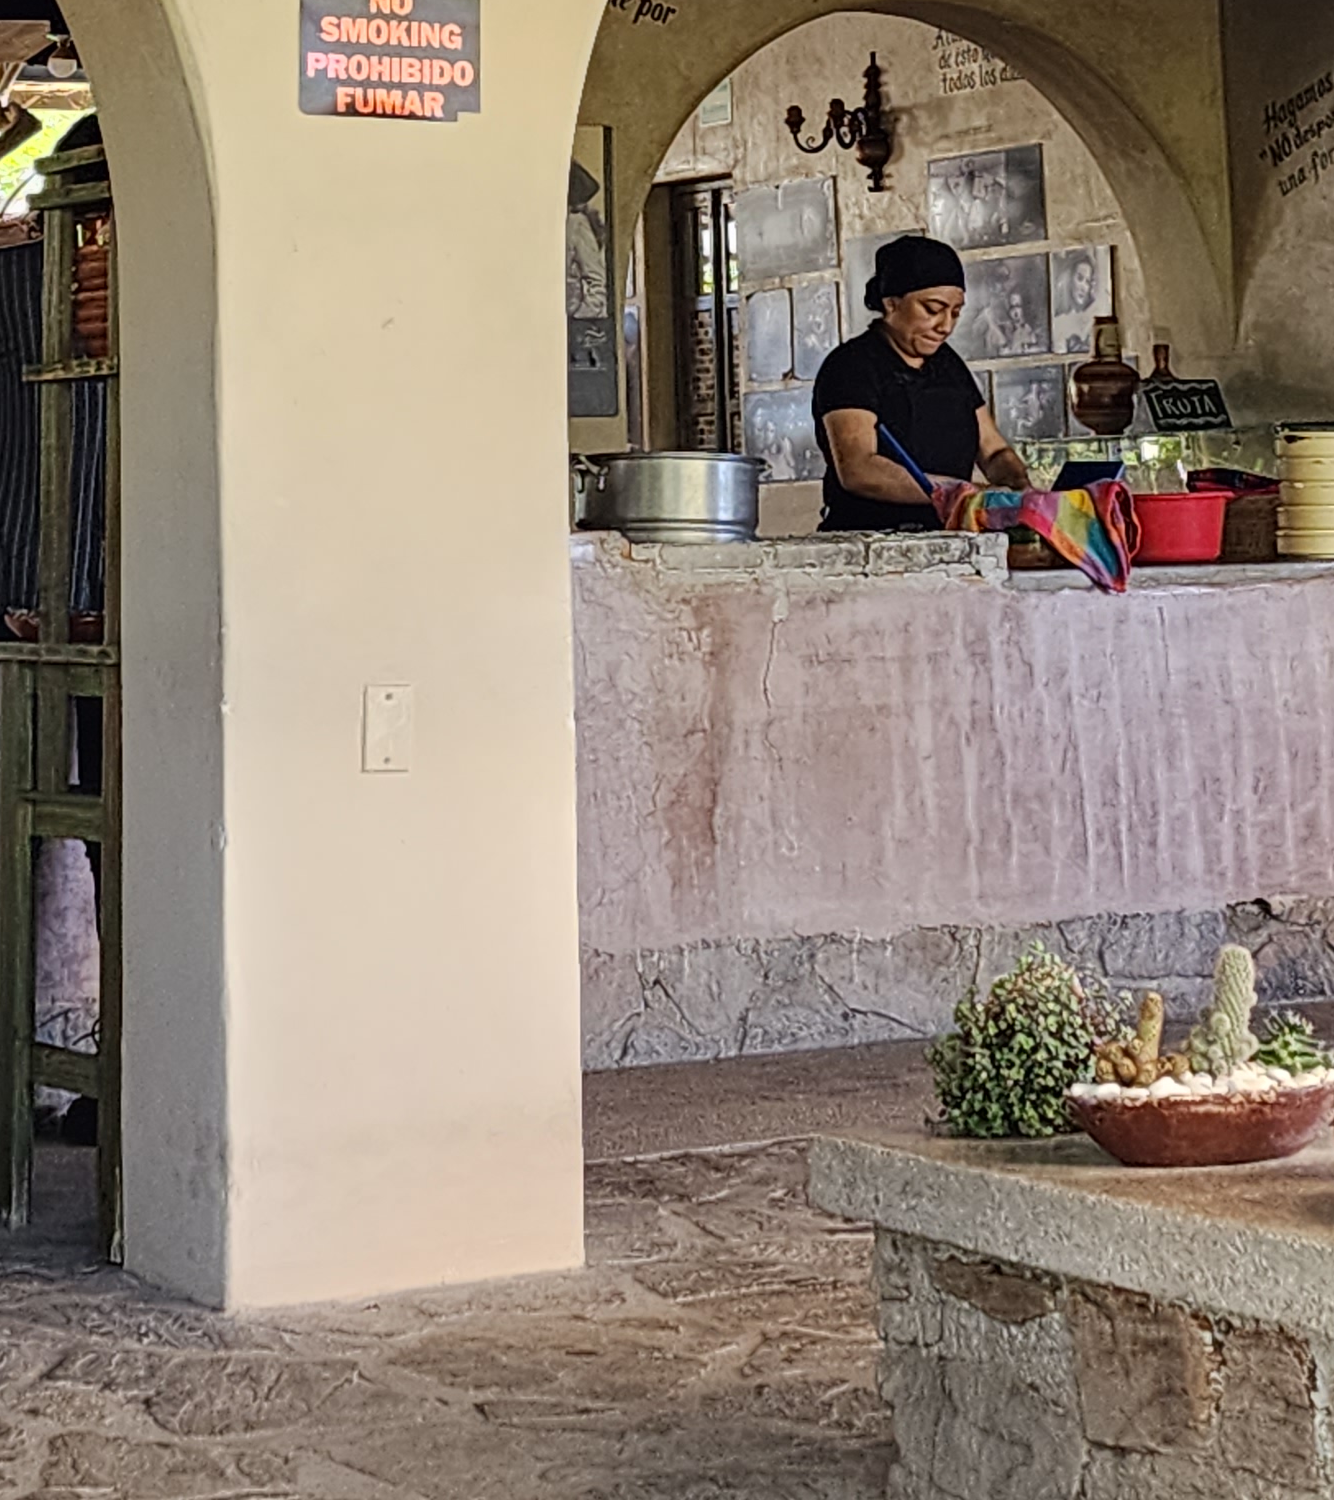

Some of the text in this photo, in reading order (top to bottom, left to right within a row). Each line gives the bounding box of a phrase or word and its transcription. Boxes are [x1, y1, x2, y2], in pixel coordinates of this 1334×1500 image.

[318, 15, 464, 50] SMOKING
[306, 51, 475, 88] PROHIBIDO
[335, 86, 446, 118] FUMAR
[1263, 72, 1334, 136] Hagamos
[1277, 159, 1308, 197] una
